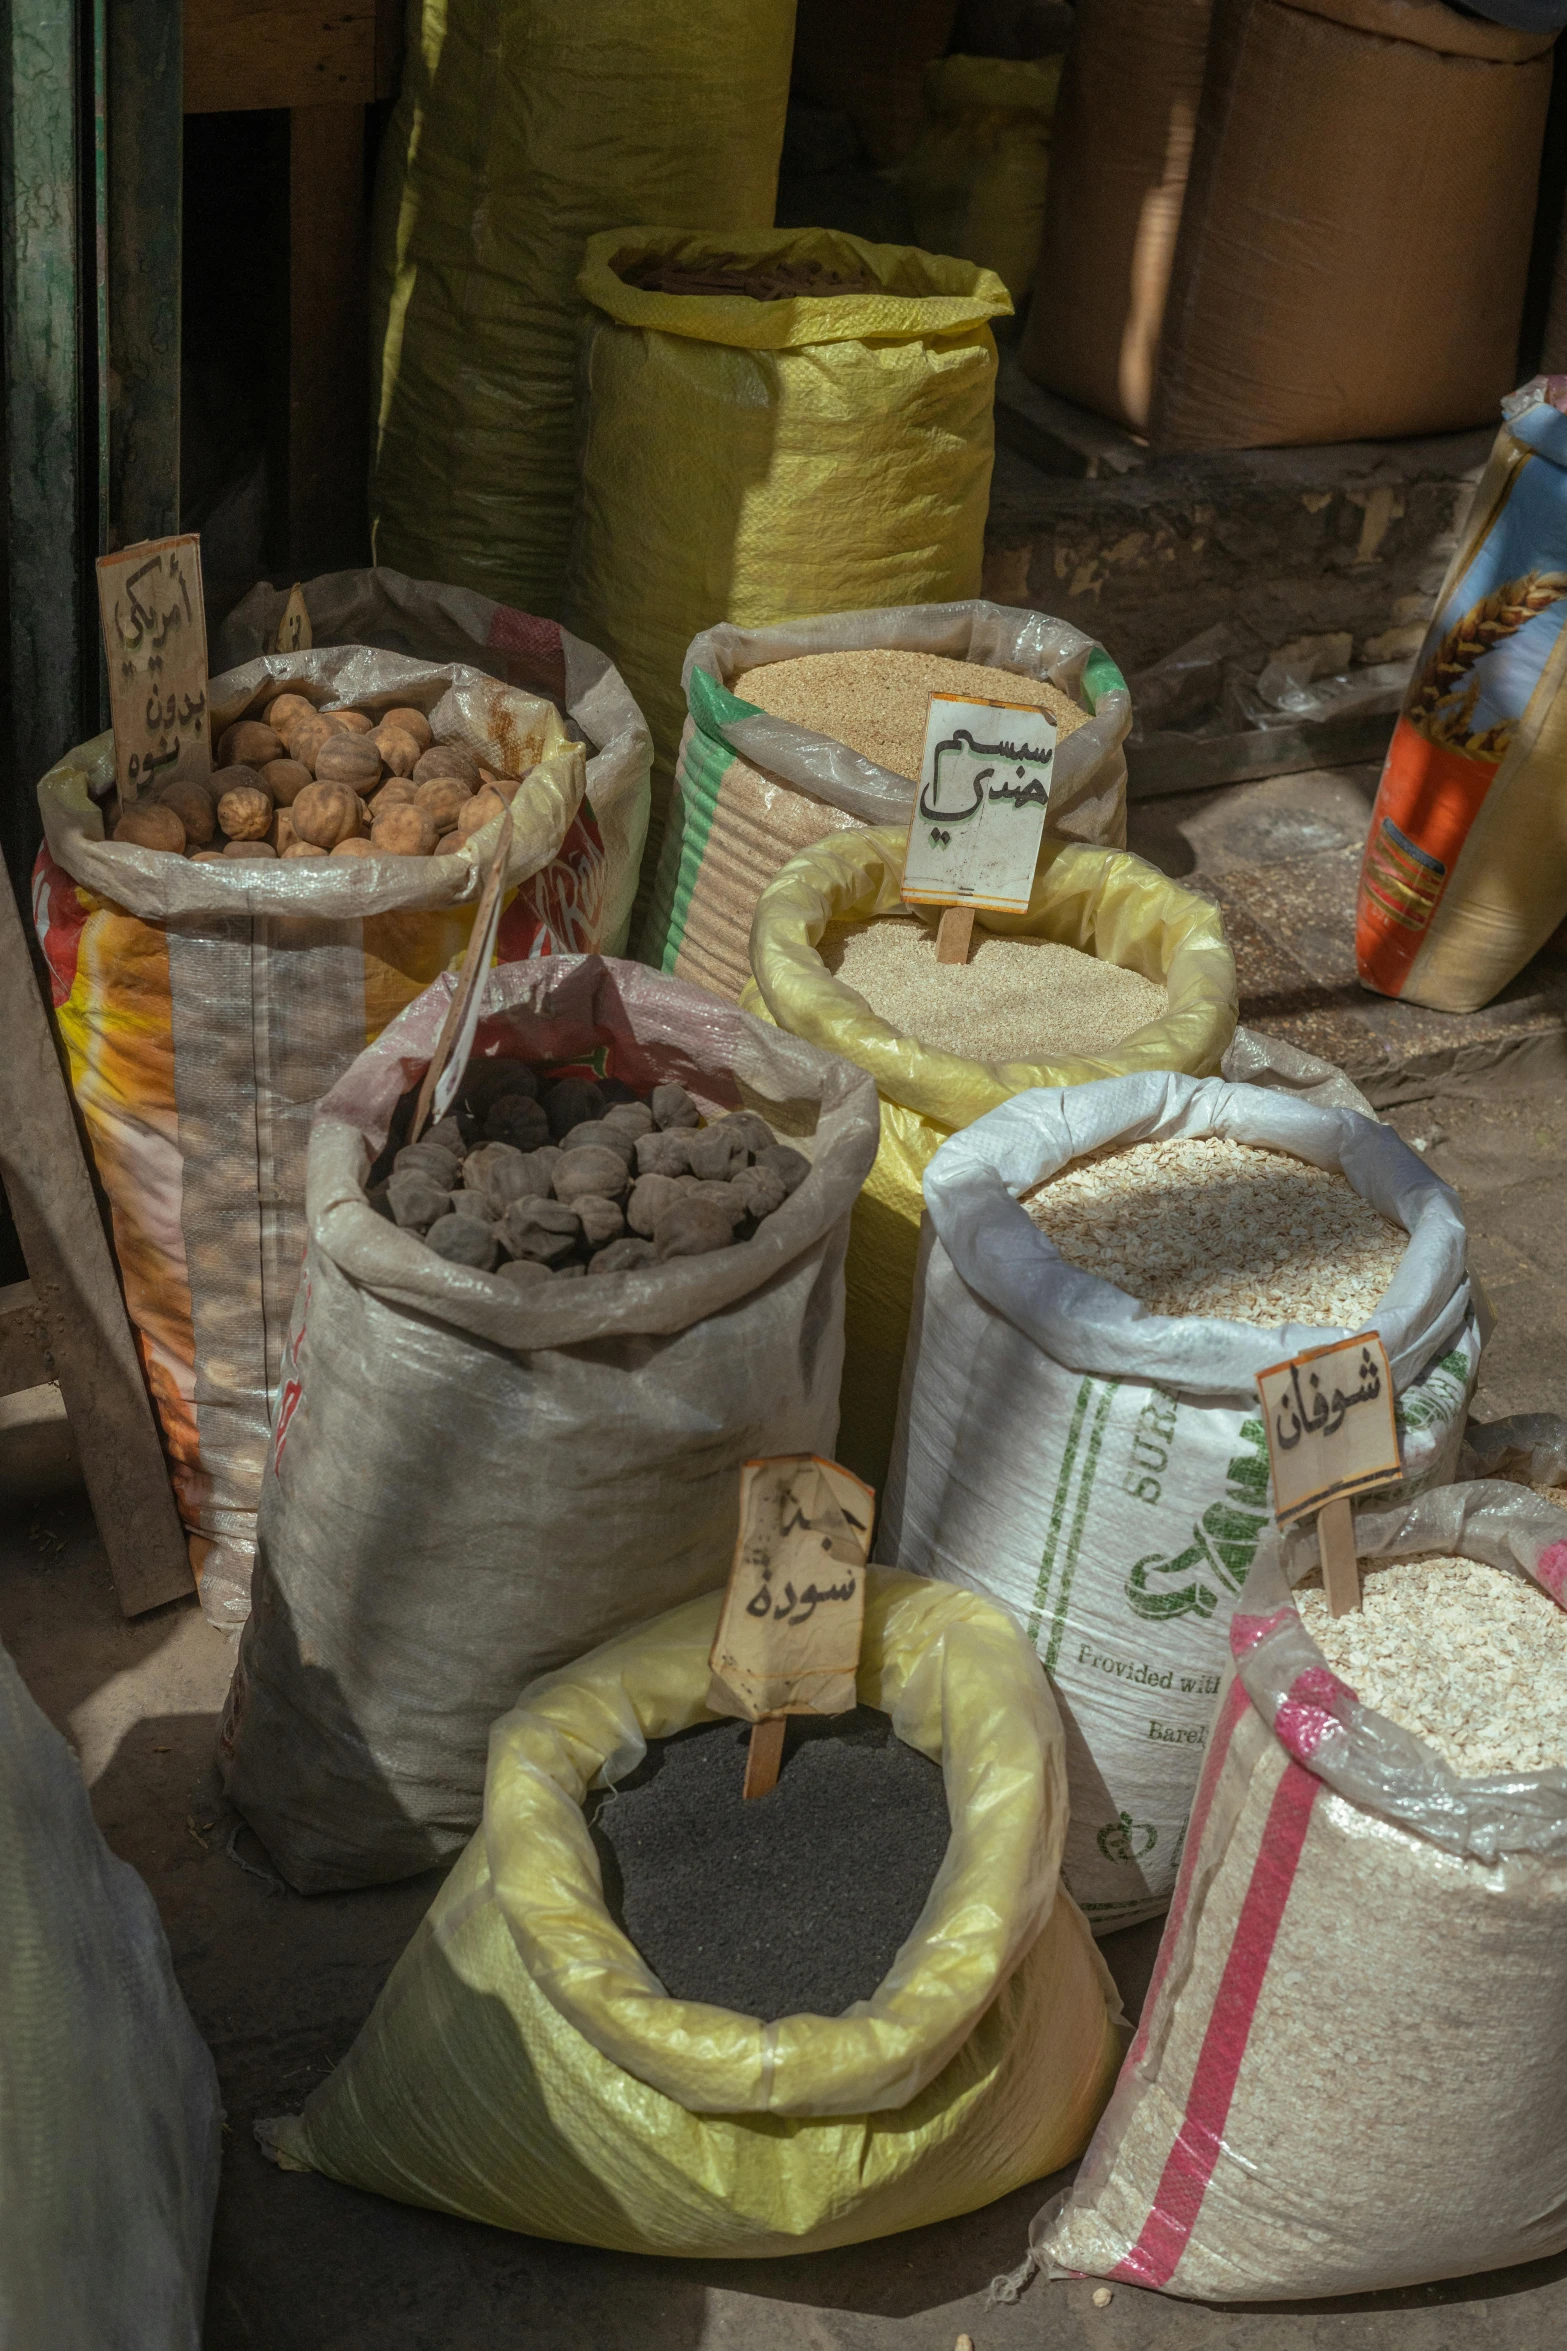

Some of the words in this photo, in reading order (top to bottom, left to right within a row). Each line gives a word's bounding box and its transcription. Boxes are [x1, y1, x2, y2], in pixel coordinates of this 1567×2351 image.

[146, 684, 205, 733] بدون
[933, 729, 1053, 806] سمسم
[1277, 1348, 1381, 1450] شوفان
[1078, 1643, 1174, 1690] Provided
